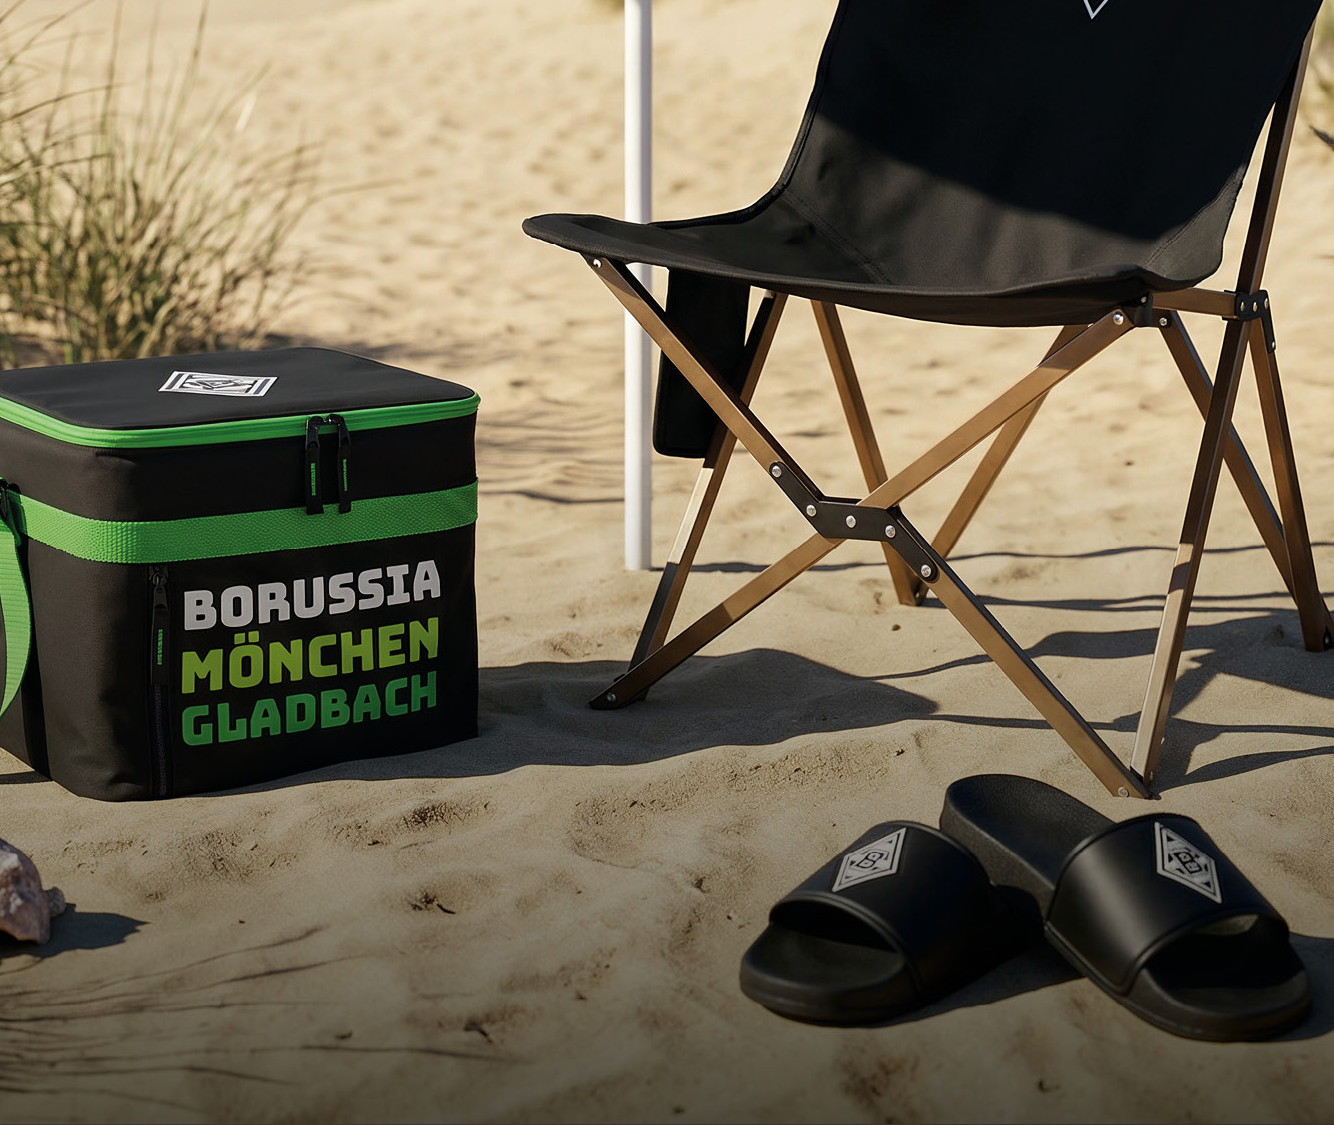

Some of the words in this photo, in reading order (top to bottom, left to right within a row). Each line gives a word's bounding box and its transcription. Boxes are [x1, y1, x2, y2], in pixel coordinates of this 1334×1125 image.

[184, 560, 441, 630] BORUSSIA
[181, 617, 439, 694] MÖNCHEN
[182, 671, 437, 746] GLADBACH
